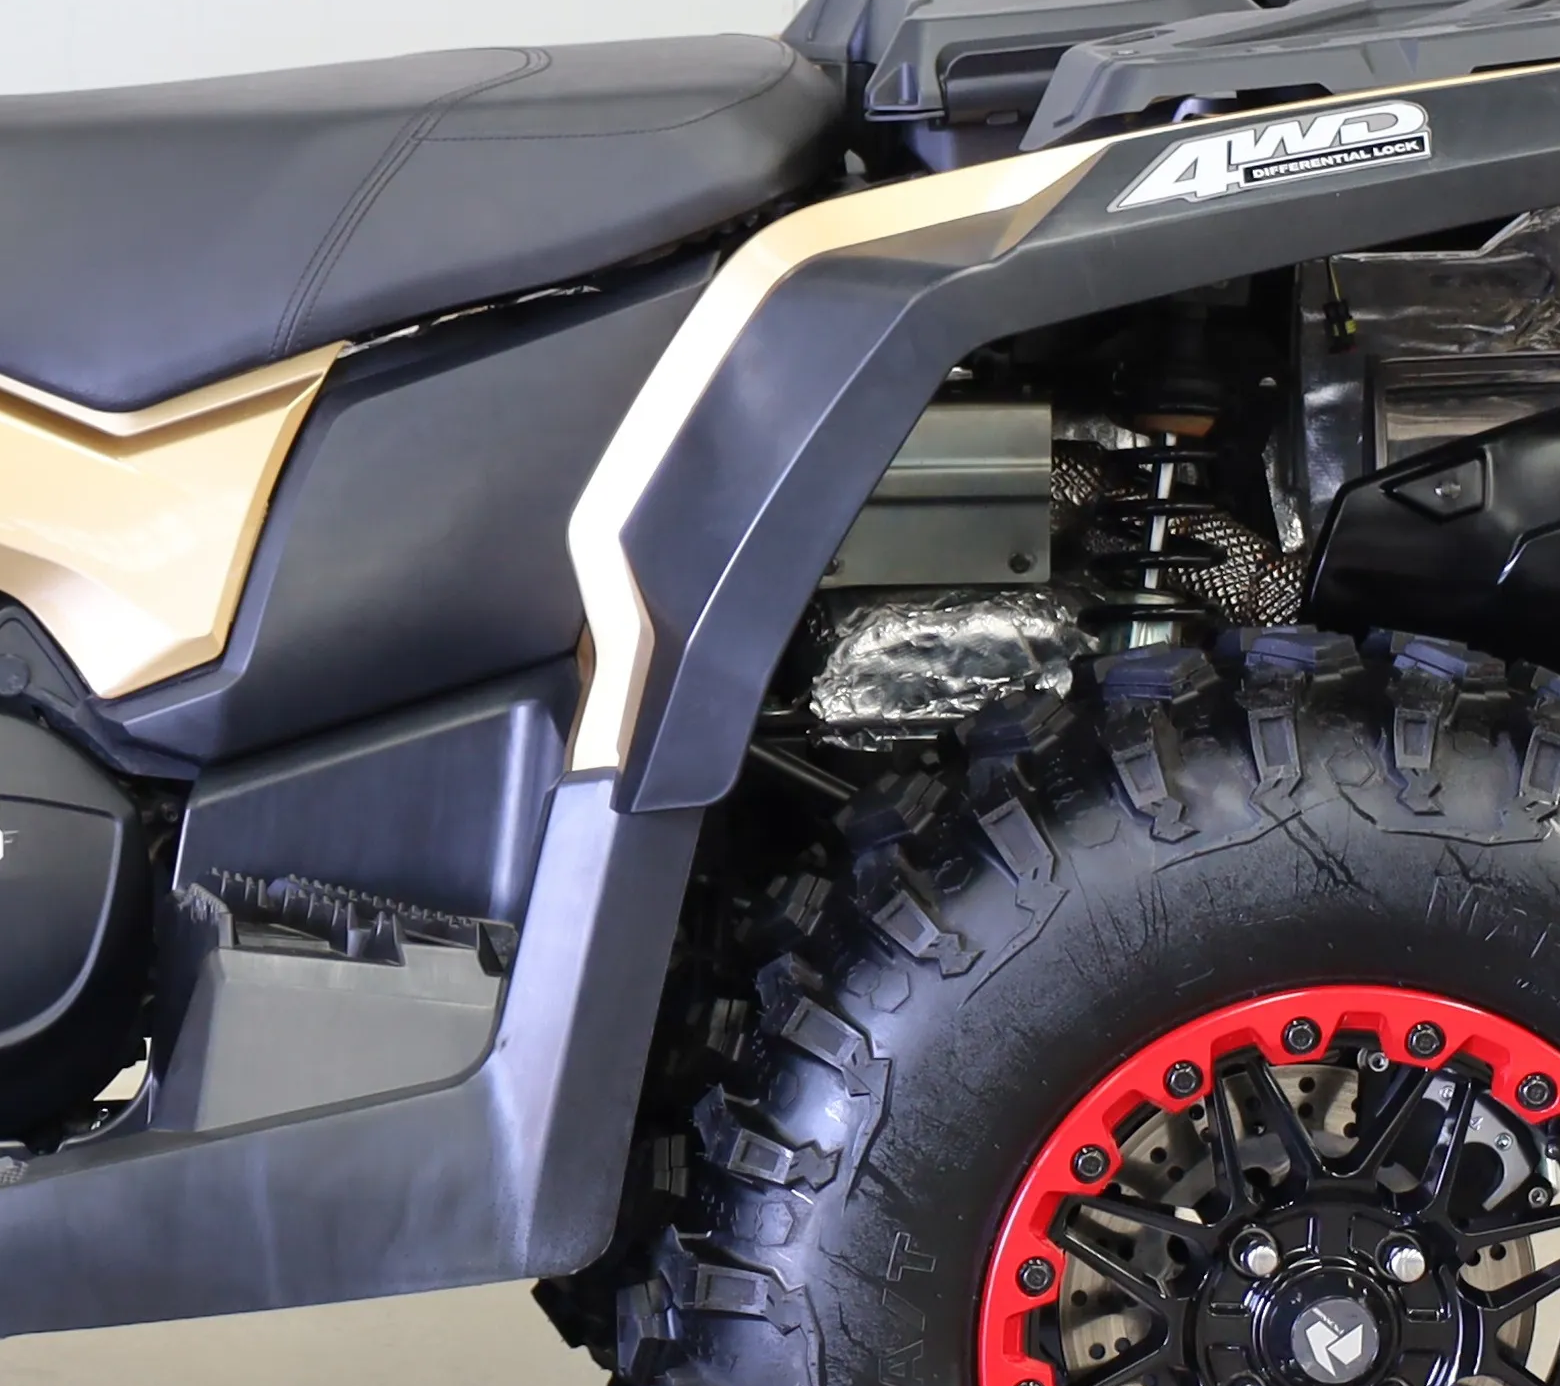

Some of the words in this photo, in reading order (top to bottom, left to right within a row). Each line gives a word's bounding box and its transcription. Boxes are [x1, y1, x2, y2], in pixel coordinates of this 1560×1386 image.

[1114, 100, 1431, 210] 4WD
[1252, 149, 1371, 179] DIFFERENTIAL
[1373, 141, 1420, 156] LOCK
